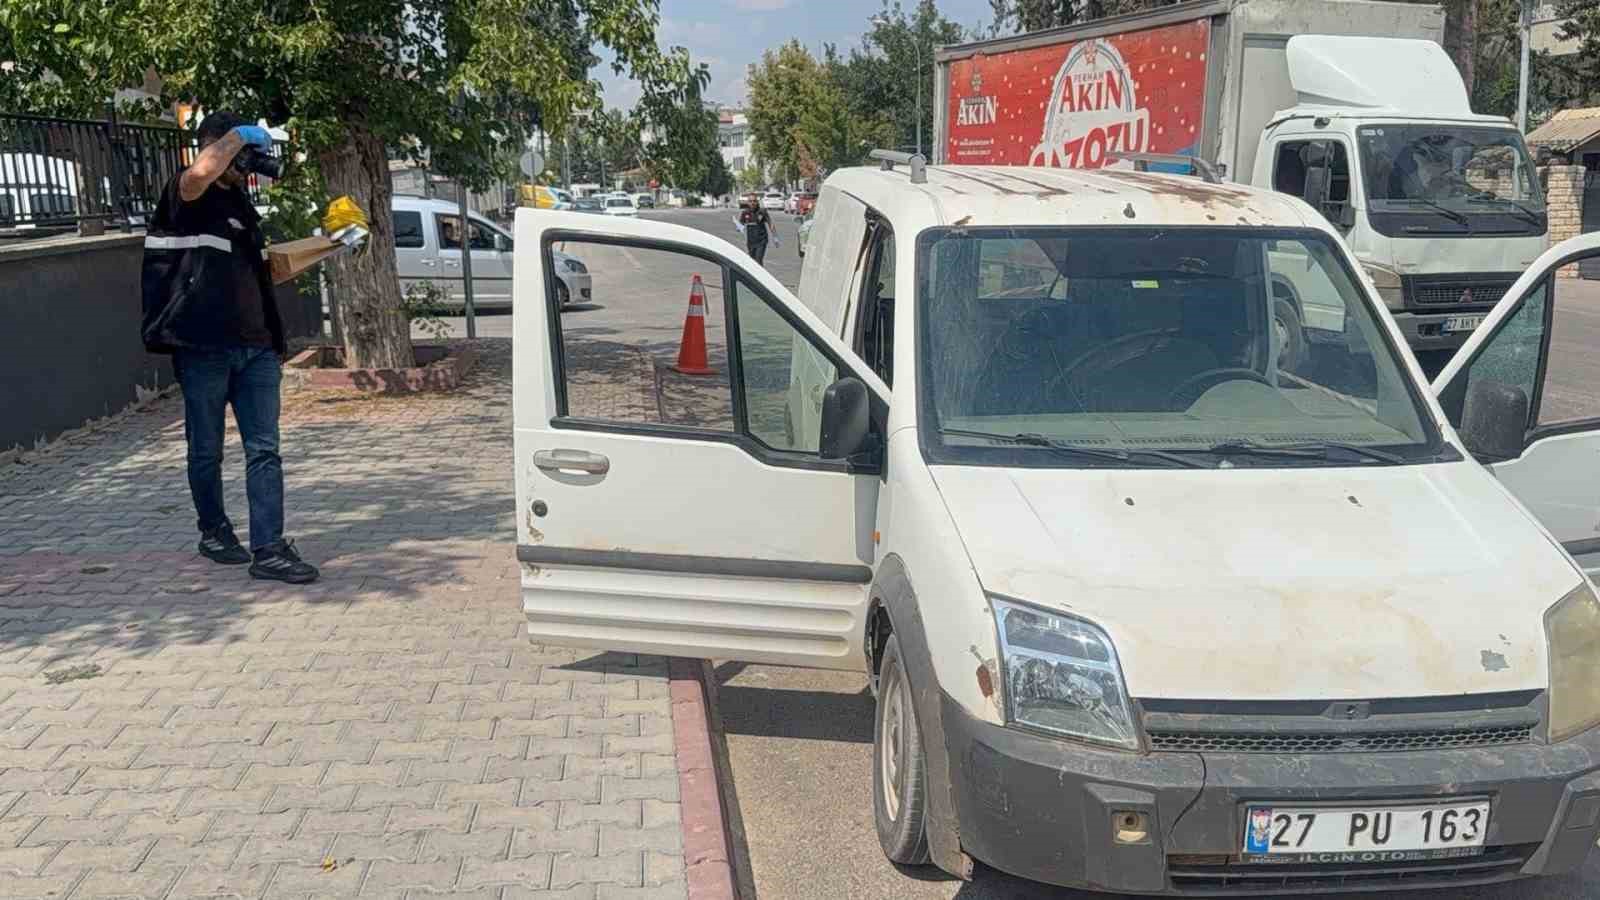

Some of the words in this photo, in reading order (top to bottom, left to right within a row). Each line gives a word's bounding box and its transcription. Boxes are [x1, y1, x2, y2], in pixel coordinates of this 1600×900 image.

[1060, 70, 1123, 113] AKIN
[957, 96, 997, 125] AKIN
[1271, 813, 1316, 846] 27
[1348, 811, 1392, 846] PU
[1421, 808, 1482, 842] 163
[1361, 850, 1405, 861] OTO
